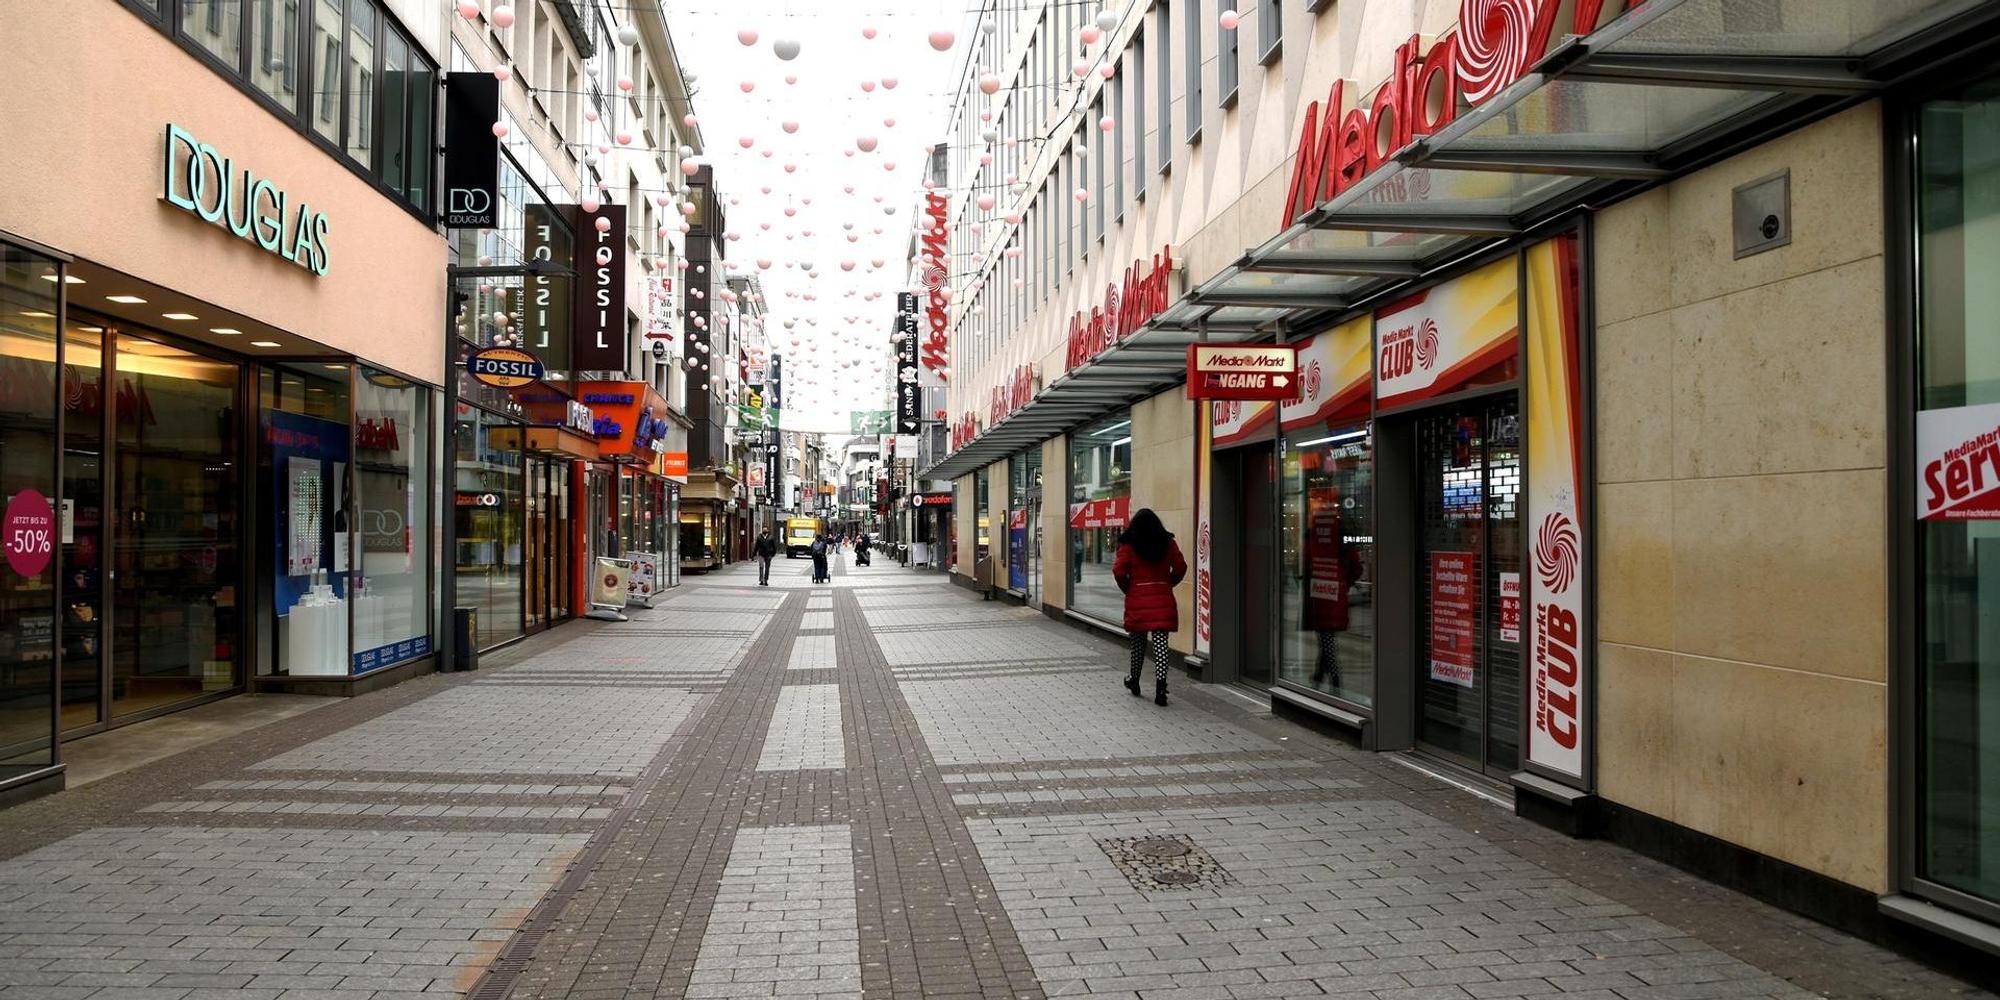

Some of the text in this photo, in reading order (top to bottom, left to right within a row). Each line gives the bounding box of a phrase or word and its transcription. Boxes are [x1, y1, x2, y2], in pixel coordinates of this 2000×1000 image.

[165, 123, 330, 277] DOUGLAS
[450, 215, 490, 224] DOUGLAS
[475, 359, 537, 377] FOSSIL
[1206, 354, 1286, 367] Media Markt
[1380, 338, 1415, 381] CLUB
[1204, 373, 1267, 388] NGANG
[13, 516, 48, 524] JETZT BIS ZU
[6, 529, 51, 553] -50%
[1200, 568, 1211, 642] CLUB
[1536, 602, 1547, 733] Media Markt
[1547, 603, 1578, 750] CLUB
